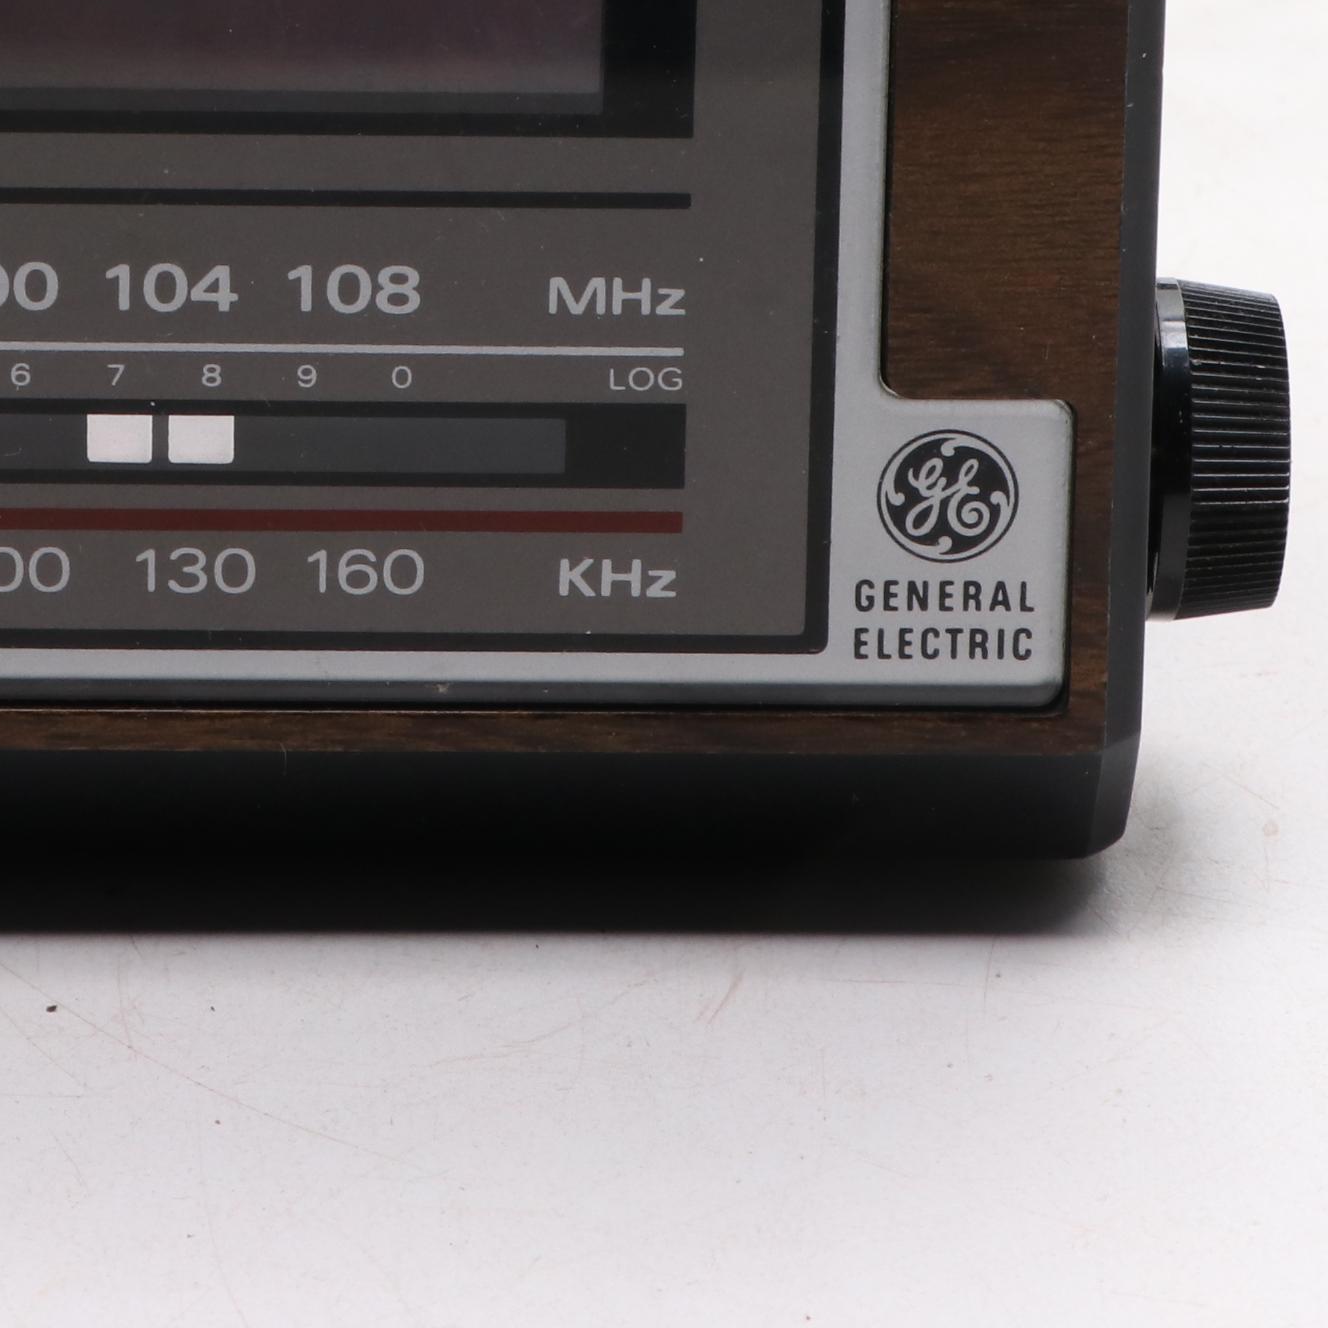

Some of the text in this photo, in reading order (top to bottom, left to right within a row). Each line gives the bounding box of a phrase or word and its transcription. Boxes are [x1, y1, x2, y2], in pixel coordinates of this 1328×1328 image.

[105, 264, 240, 312] 104
[287, 265, 422, 315] 108
[548, 277, 686, 316] MHz
[10, 364, 31, 386] 6
[107, 364, 126, 386] 7
[201, 364, 222, 387] 8
[297, 365, 318, 387] 9
[391, 365, 413, 389] 0
[609, 368, 684, 391] LOG
[135, 549, 256, 594] 130
[307, 549, 424, 595] 160
[558, 558, 678, 598] KHz
[855, 579, 1034, 612] GENERAL
[854, 628, 1033, 660] ELECTRIC
